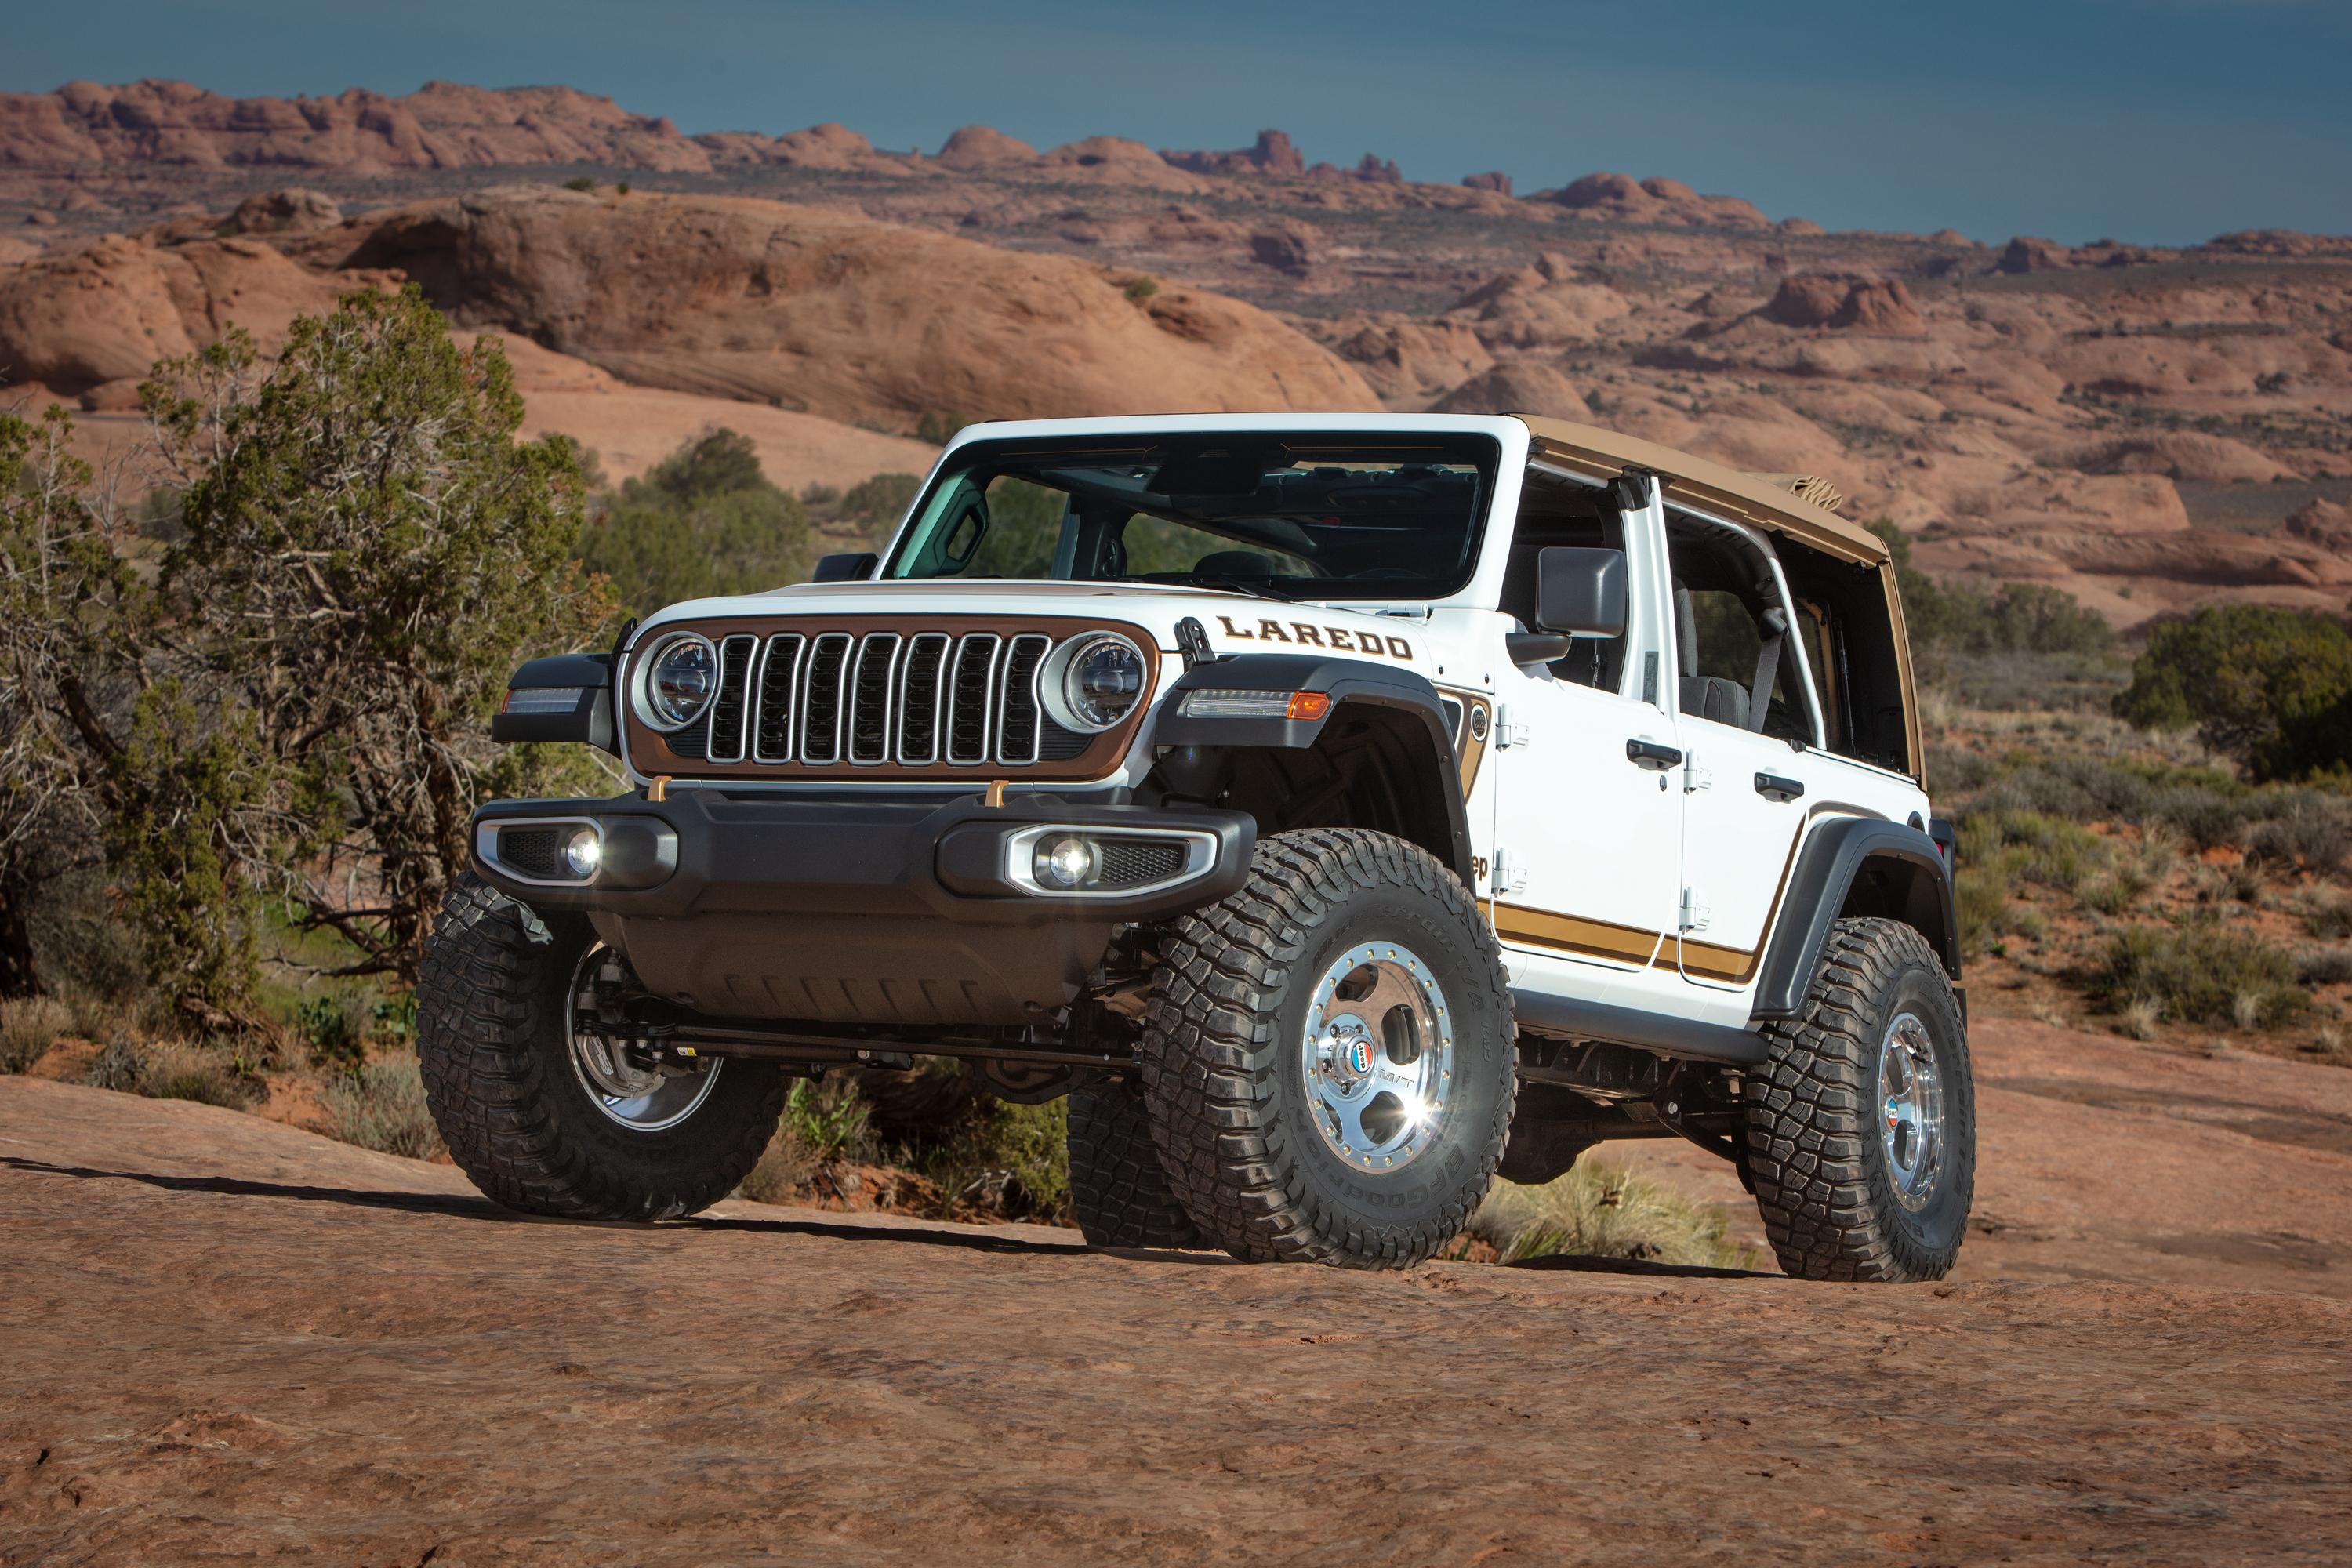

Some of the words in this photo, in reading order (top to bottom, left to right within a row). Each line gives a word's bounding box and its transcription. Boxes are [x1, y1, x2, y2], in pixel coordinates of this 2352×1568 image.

[1216, 615, 1413, 660] LAREDO
[1472, 855, 1488, 881] ep
[1380, 1069, 1414, 1088] M/T
